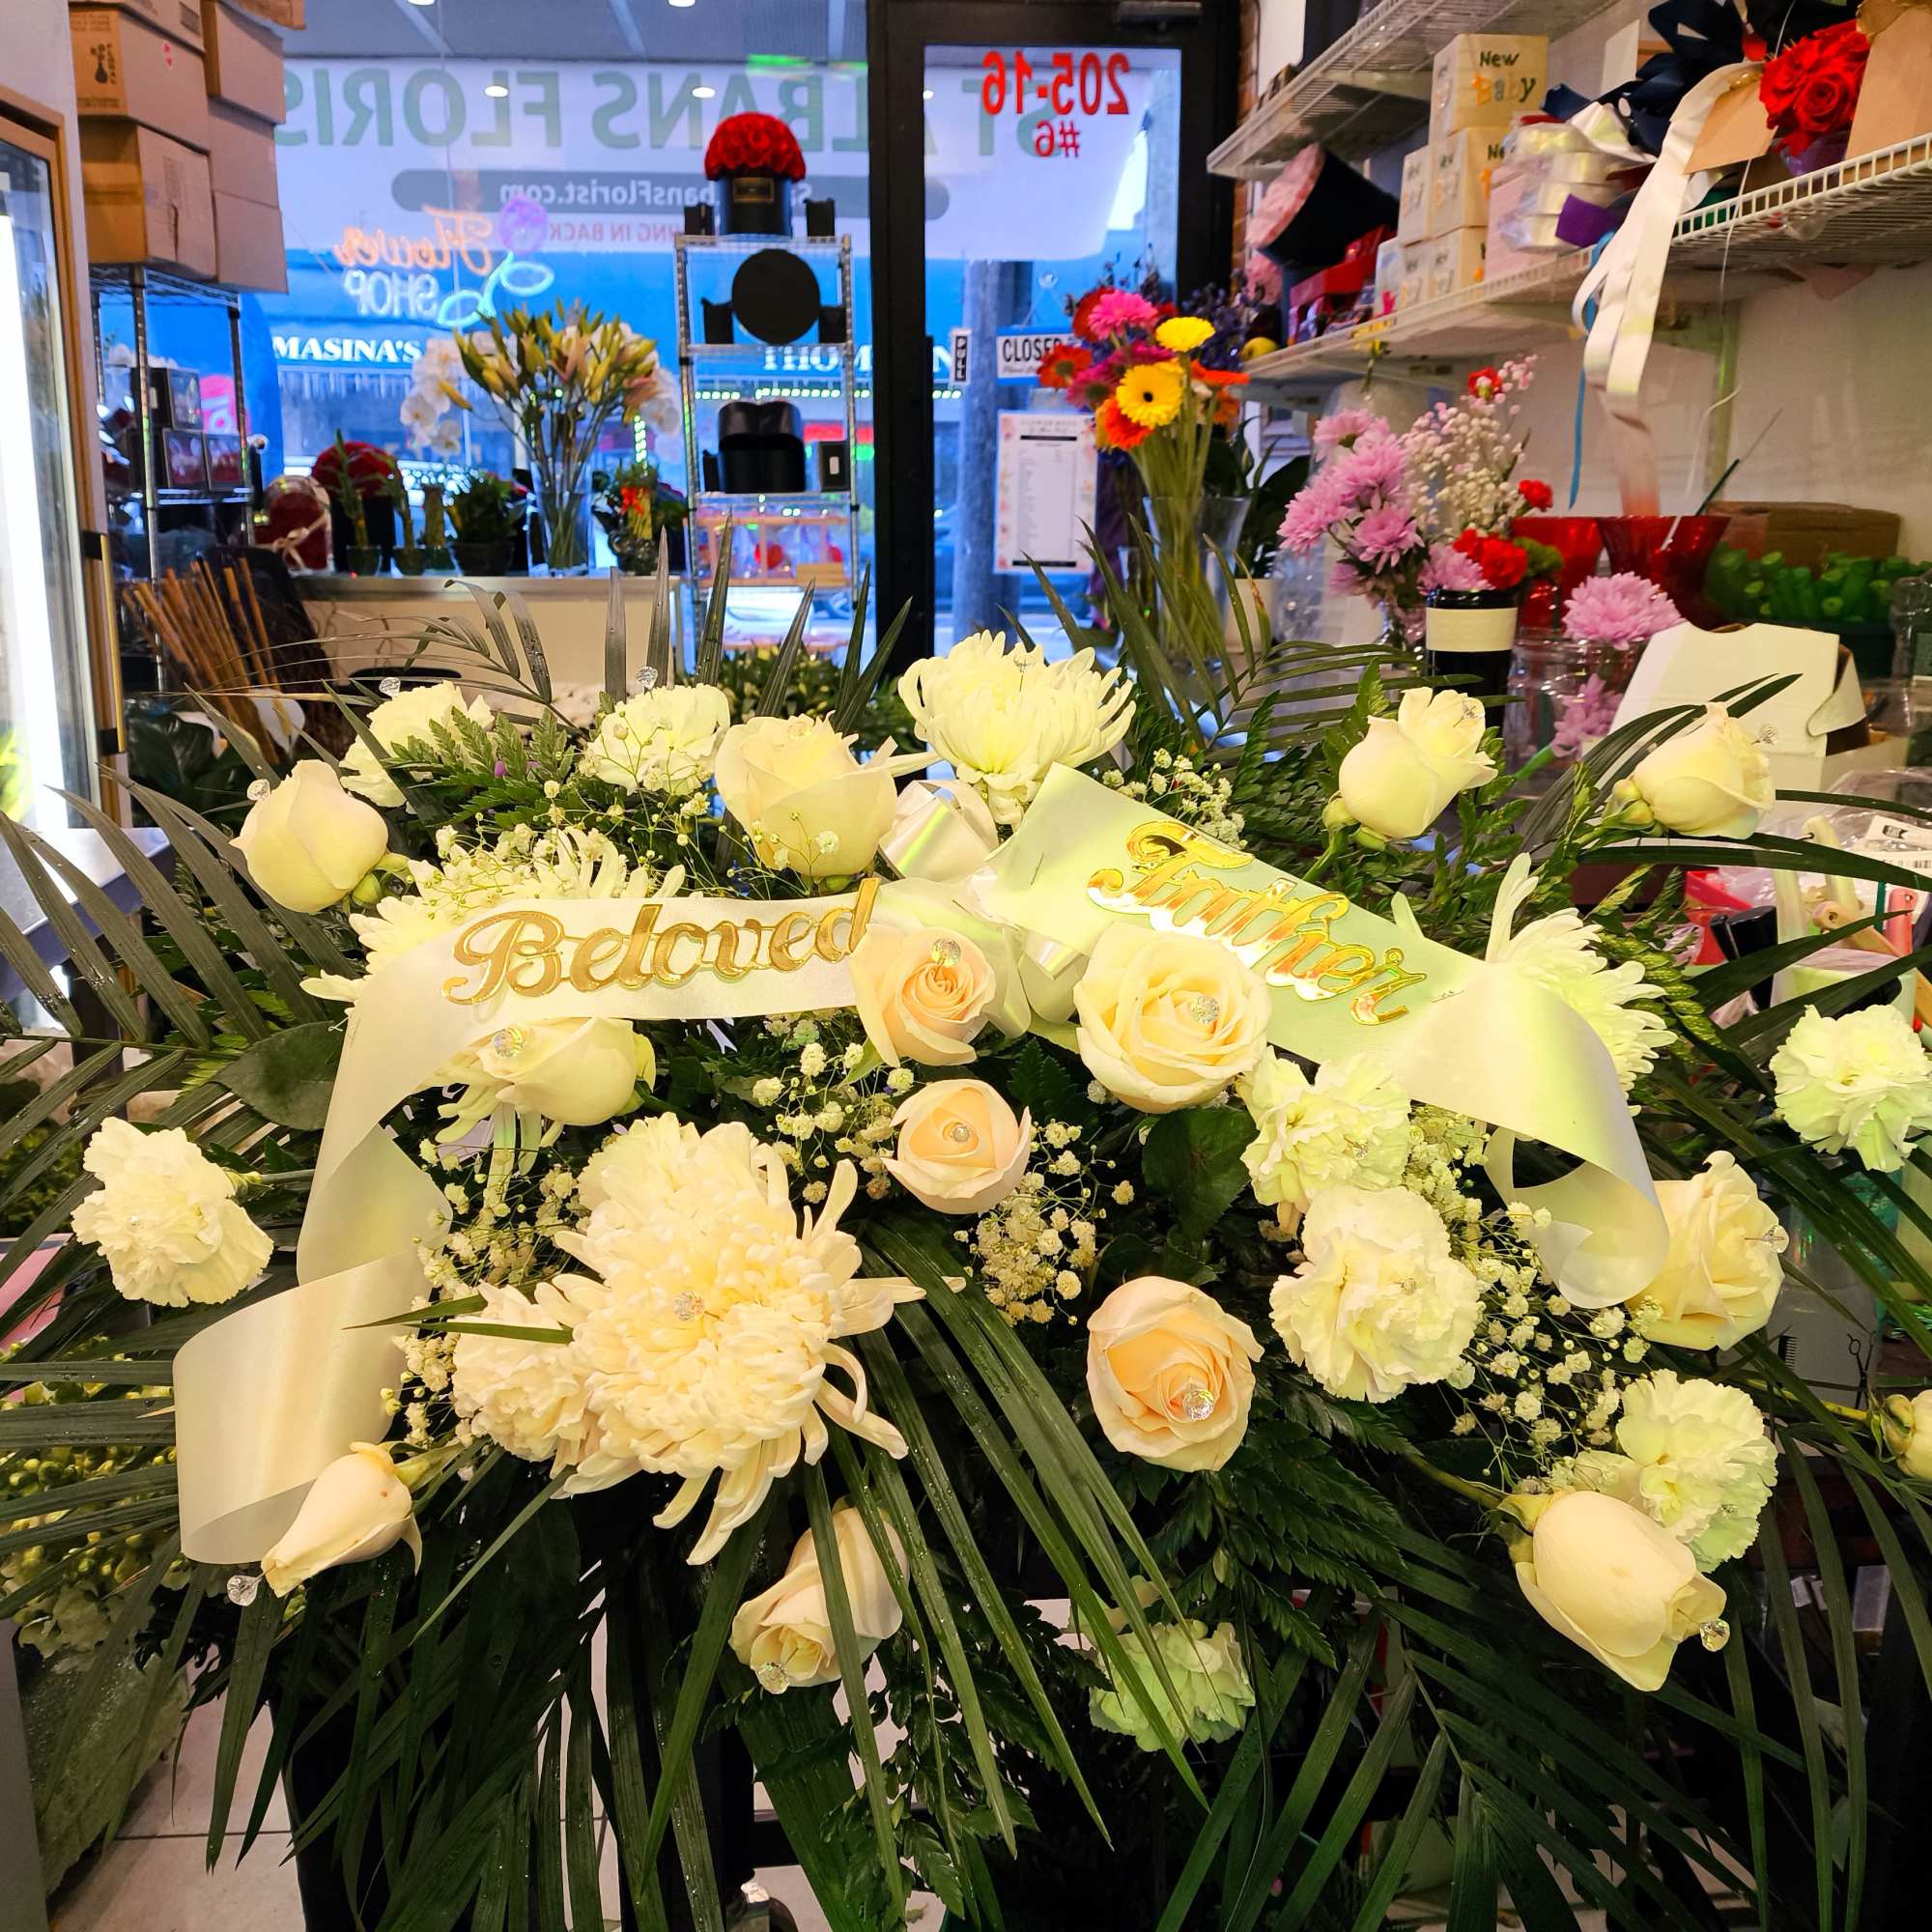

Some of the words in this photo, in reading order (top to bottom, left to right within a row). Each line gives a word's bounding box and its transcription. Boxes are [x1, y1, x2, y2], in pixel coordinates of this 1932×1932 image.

[1479, 50, 1520, 67] New
[272, 335, 423, 363] MASINA'S
[955, 337, 967, 379] PULL
[441, 876, 882, 1006] Beloved
[1086, 820, 1428, 1026] Father
